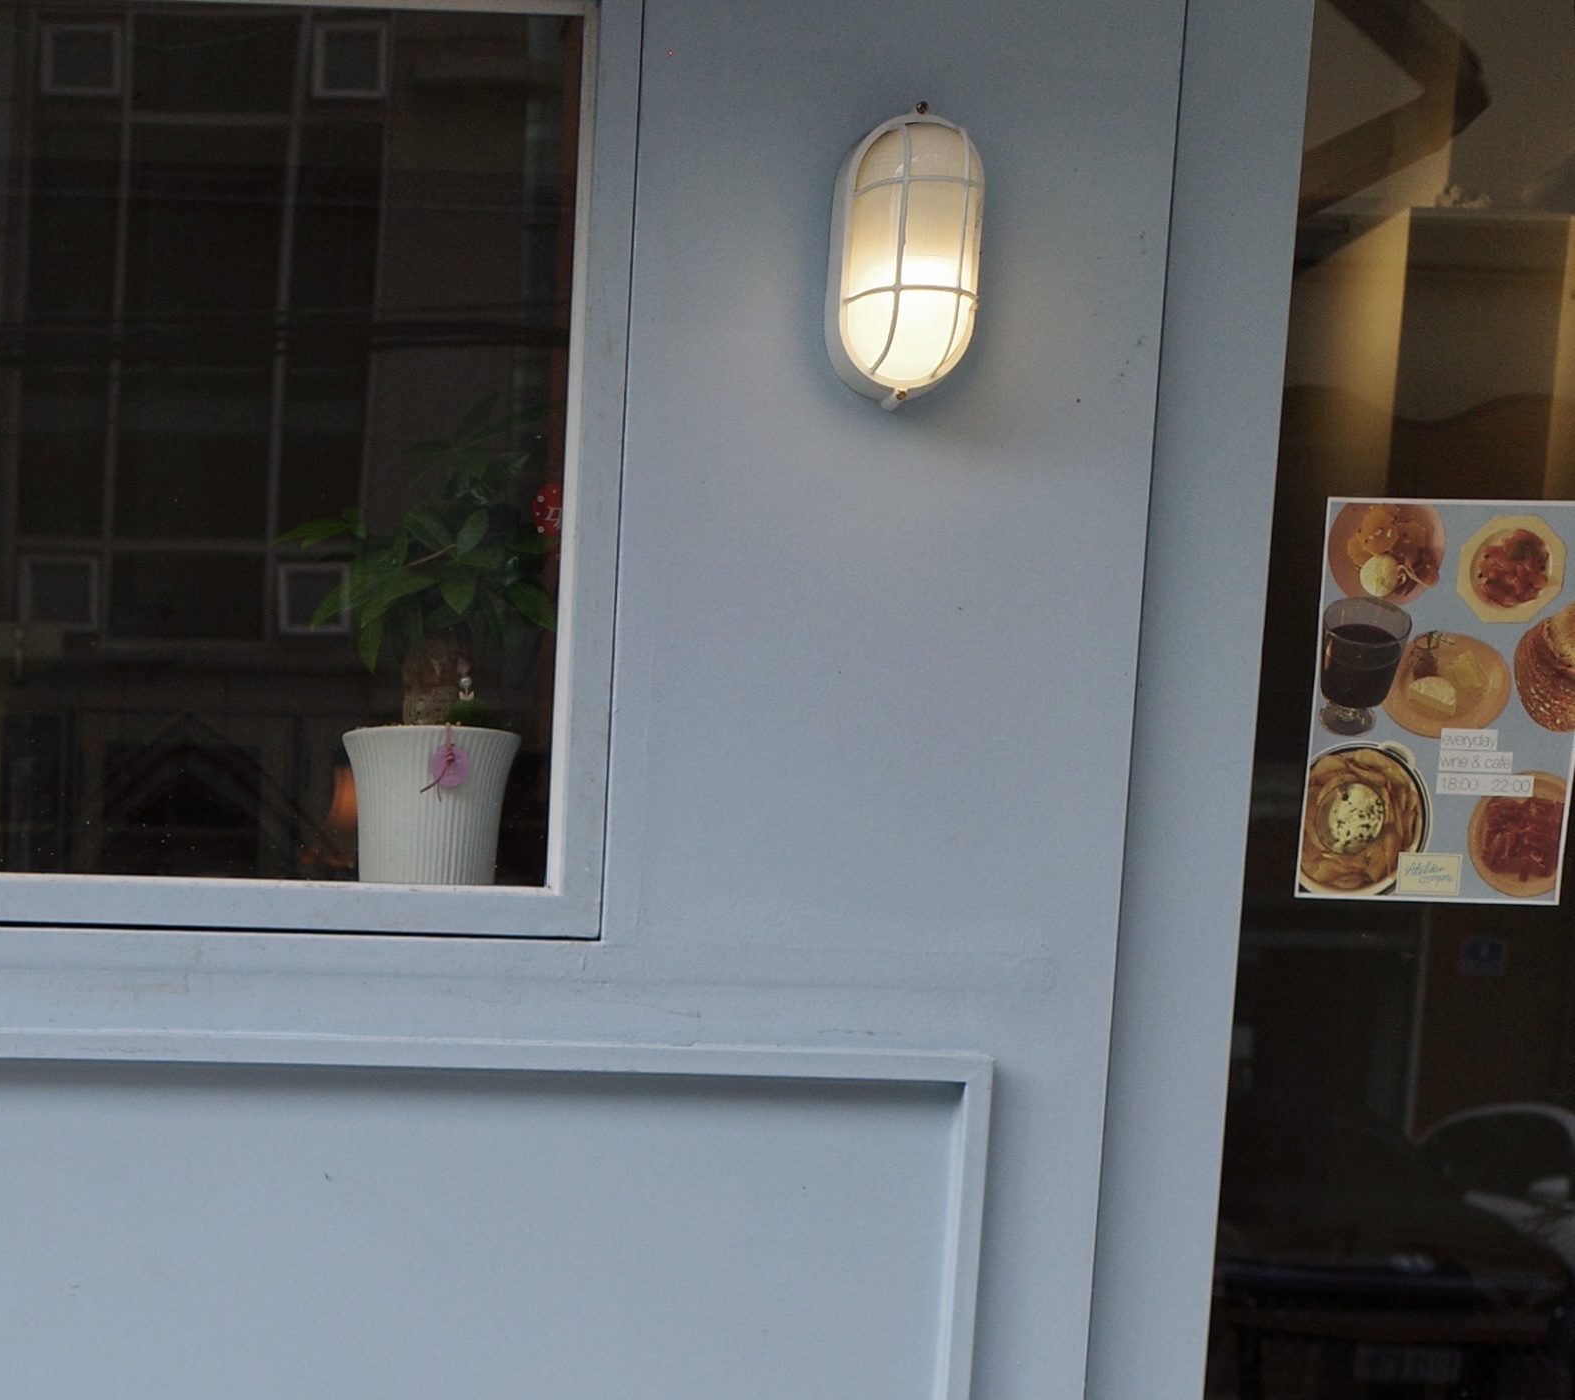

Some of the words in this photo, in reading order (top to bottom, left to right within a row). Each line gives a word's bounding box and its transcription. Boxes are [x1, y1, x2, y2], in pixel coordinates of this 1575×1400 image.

[1442, 733, 1496, 749] everyday
[1471, 754, 1480, 769] &
[1485, 756, 1511, 770] cafe
